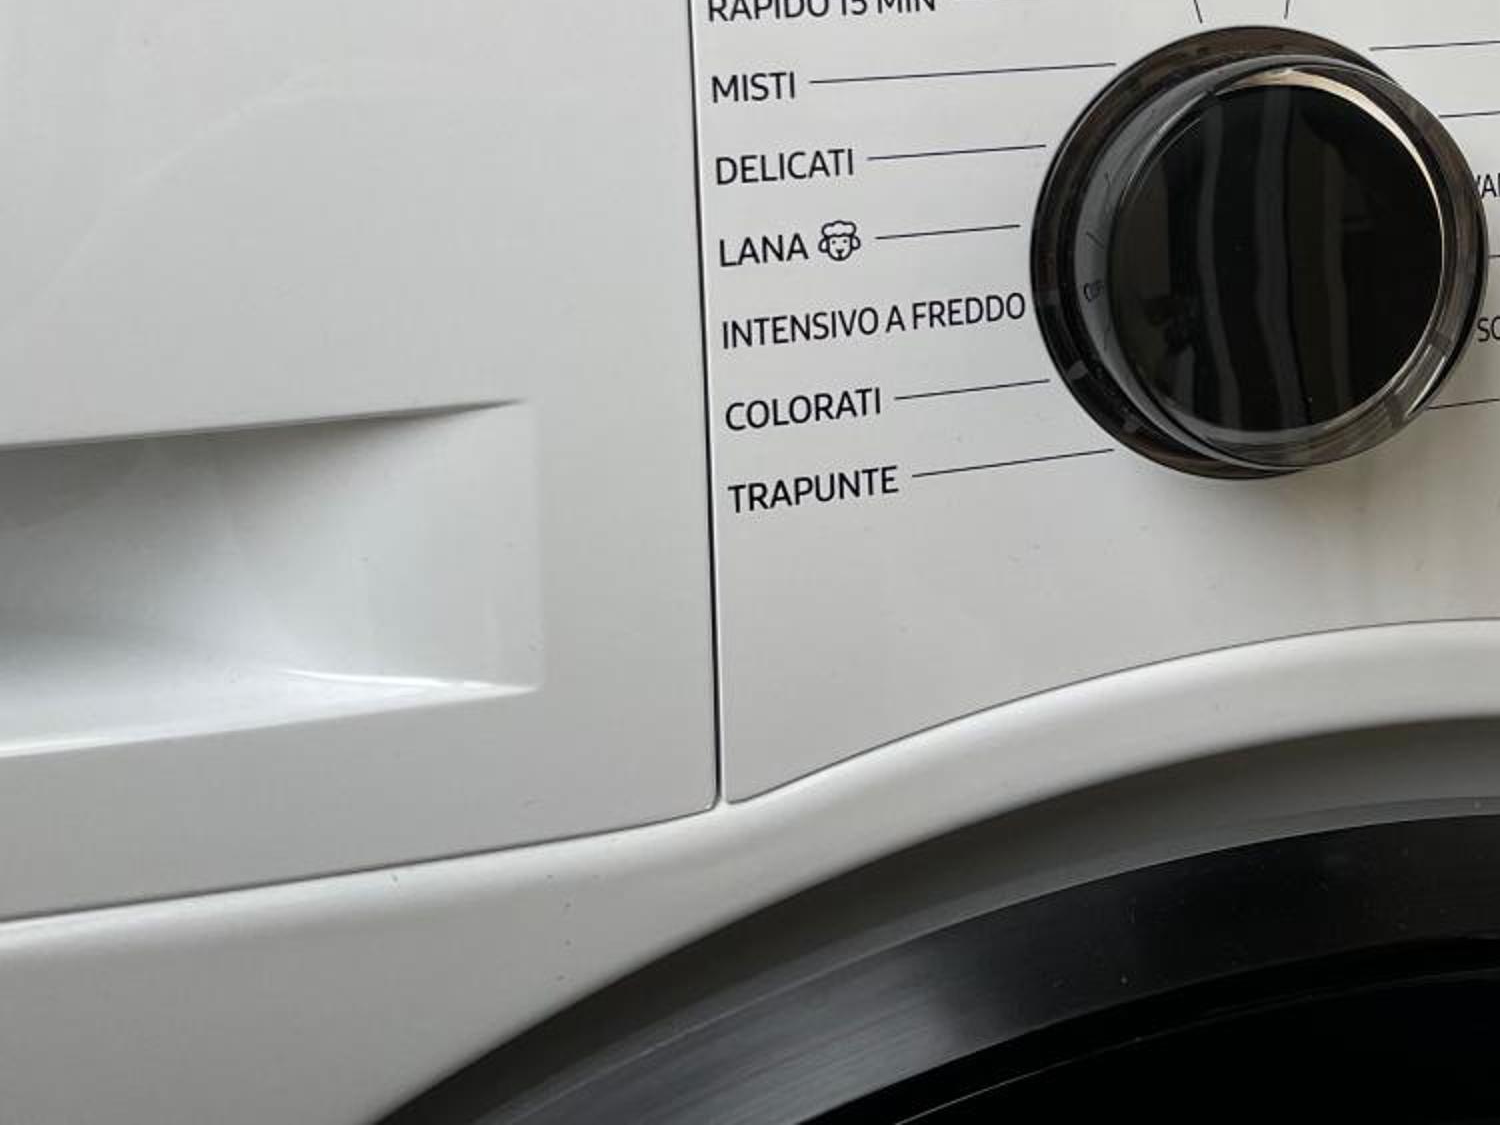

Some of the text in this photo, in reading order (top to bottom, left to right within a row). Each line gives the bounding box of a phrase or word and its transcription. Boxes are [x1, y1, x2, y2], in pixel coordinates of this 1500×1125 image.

[711, 71, 797, 103] MISTI
[715, 148, 854, 184] DELICATI
[719, 233, 809, 267] LANA
[722, 292, 1026, 349] INTENSIVO A FREDDO
[725, 387, 881, 431] COLORATI
[728, 466, 898, 513] TRAPUNTE
